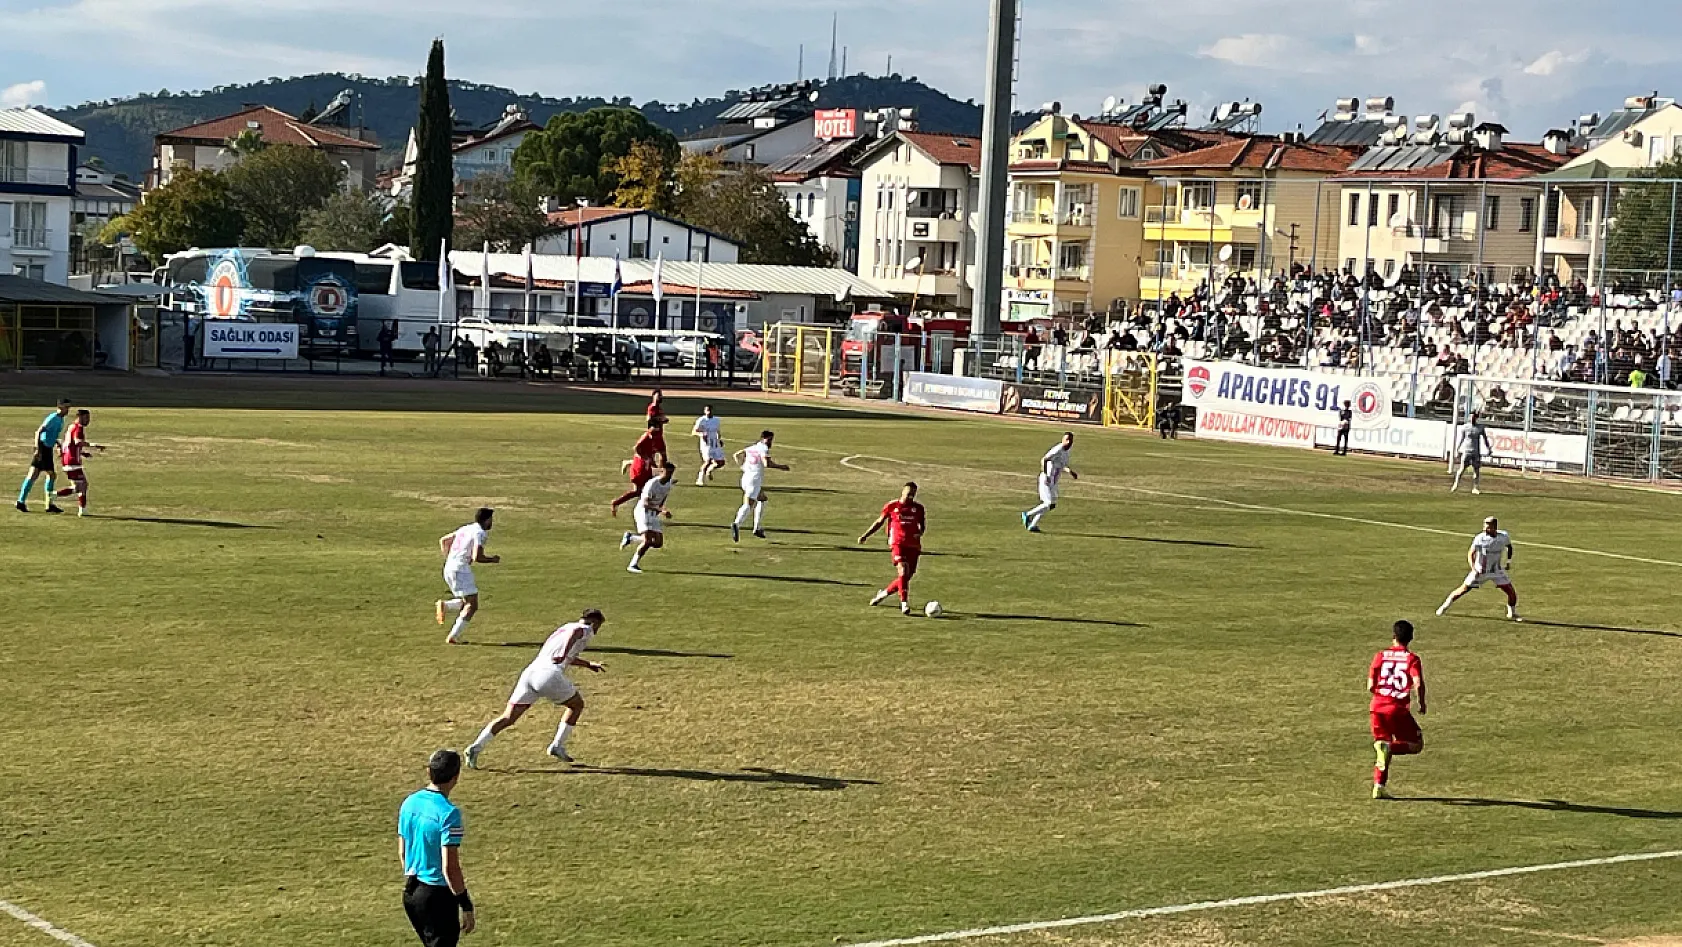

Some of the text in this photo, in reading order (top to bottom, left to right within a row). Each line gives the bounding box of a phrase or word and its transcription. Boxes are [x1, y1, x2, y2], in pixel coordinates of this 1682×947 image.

[815, 119, 854, 137] HOTEL
[211, 327, 293, 343] SAĞLIK ODASI
[1217, 371, 1311, 407] APACHES
[1315, 383, 1340, 410] 91
[1201, 411, 1310, 440] ABDULLAH KOYUNCU
[1378, 661, 1407, 690] 55
